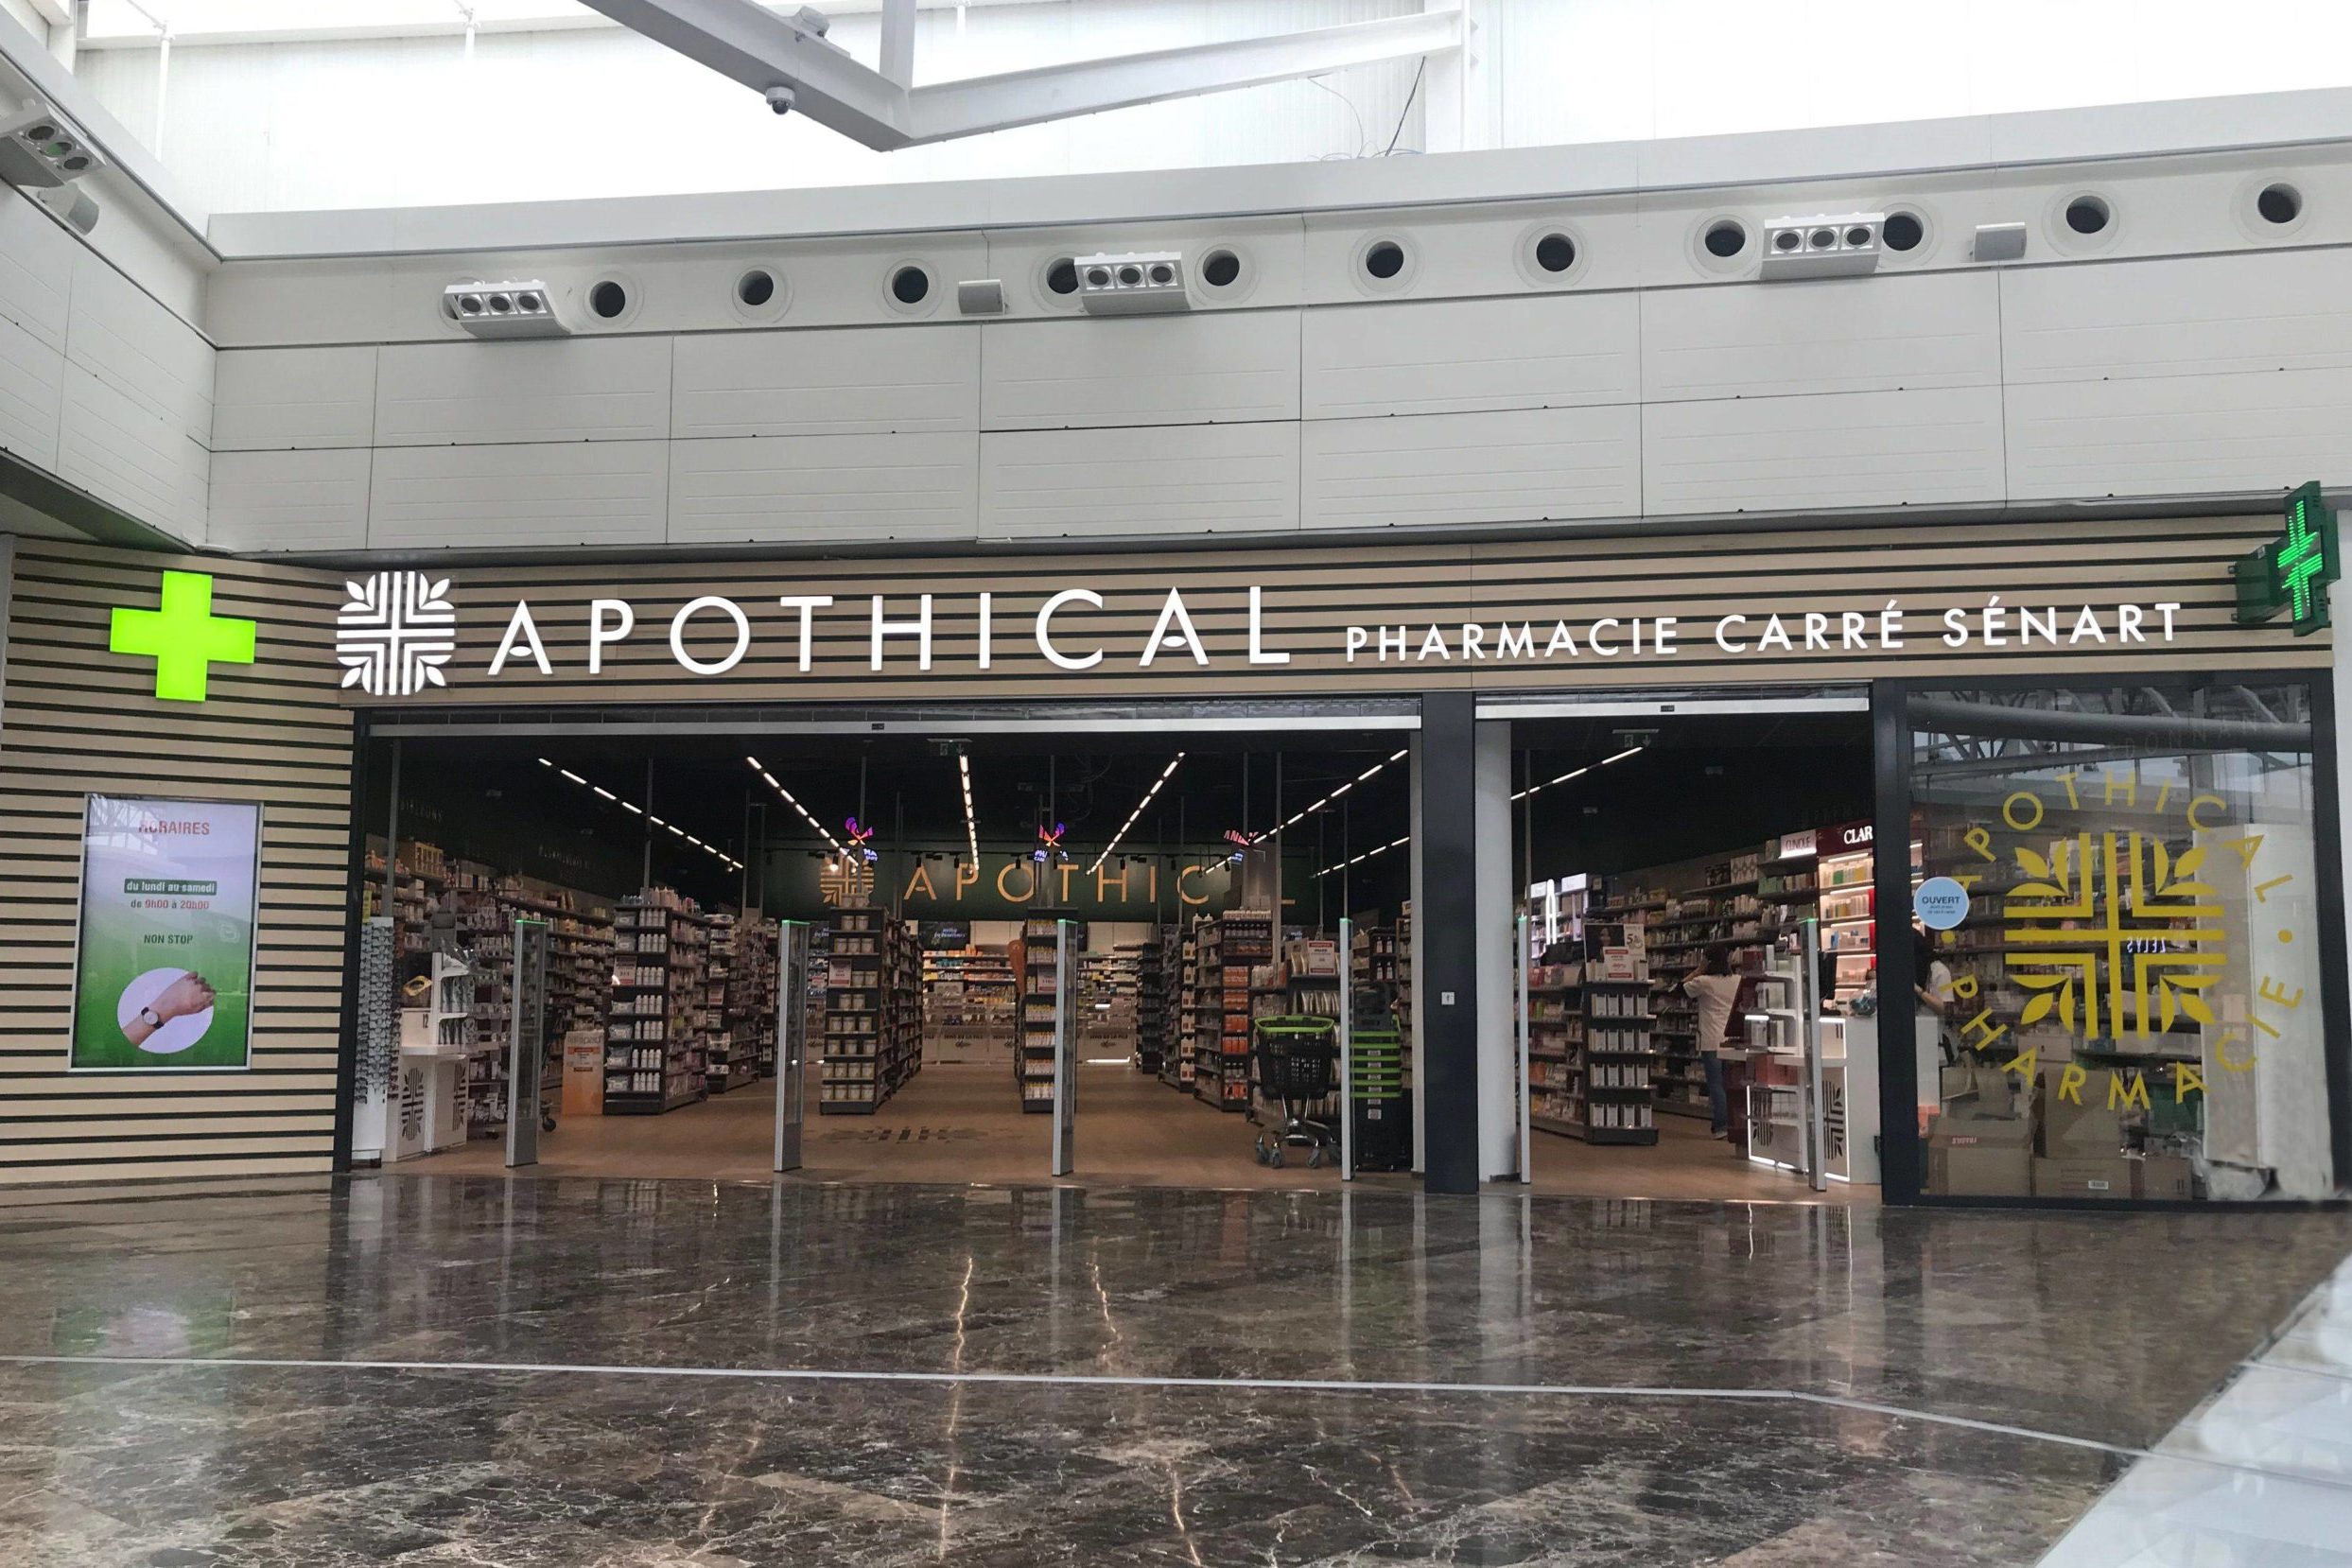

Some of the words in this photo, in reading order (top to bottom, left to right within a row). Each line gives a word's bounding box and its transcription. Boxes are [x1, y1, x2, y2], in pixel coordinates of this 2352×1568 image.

[488, 585, 1291, 675] APOTHICAL
[1346, 617, 1679, 662] PHARMACIE
[1715, 600, 1905, 653] CARRÉ
[1943, 595, 2181, 648] SÉNART
[126, 880, 139, 891] du
[141, 880, 166, 892] lundi
[167, 883, 180, 892] au
[182, 881, 215, 893] samedi
[904, 863, 1296, 905] APOTHIC
[131, 897, 142, 908] de
[145, 897, 169, 909] 9h00
[171, 898, 178, 909] à
[1922, 896, 1960, 905] OUVERT
[144, 933, 165, 944] NON
[167, 934, 193, 944] STOP
[1938, 973, 2304, 1111] PHARMACIE
